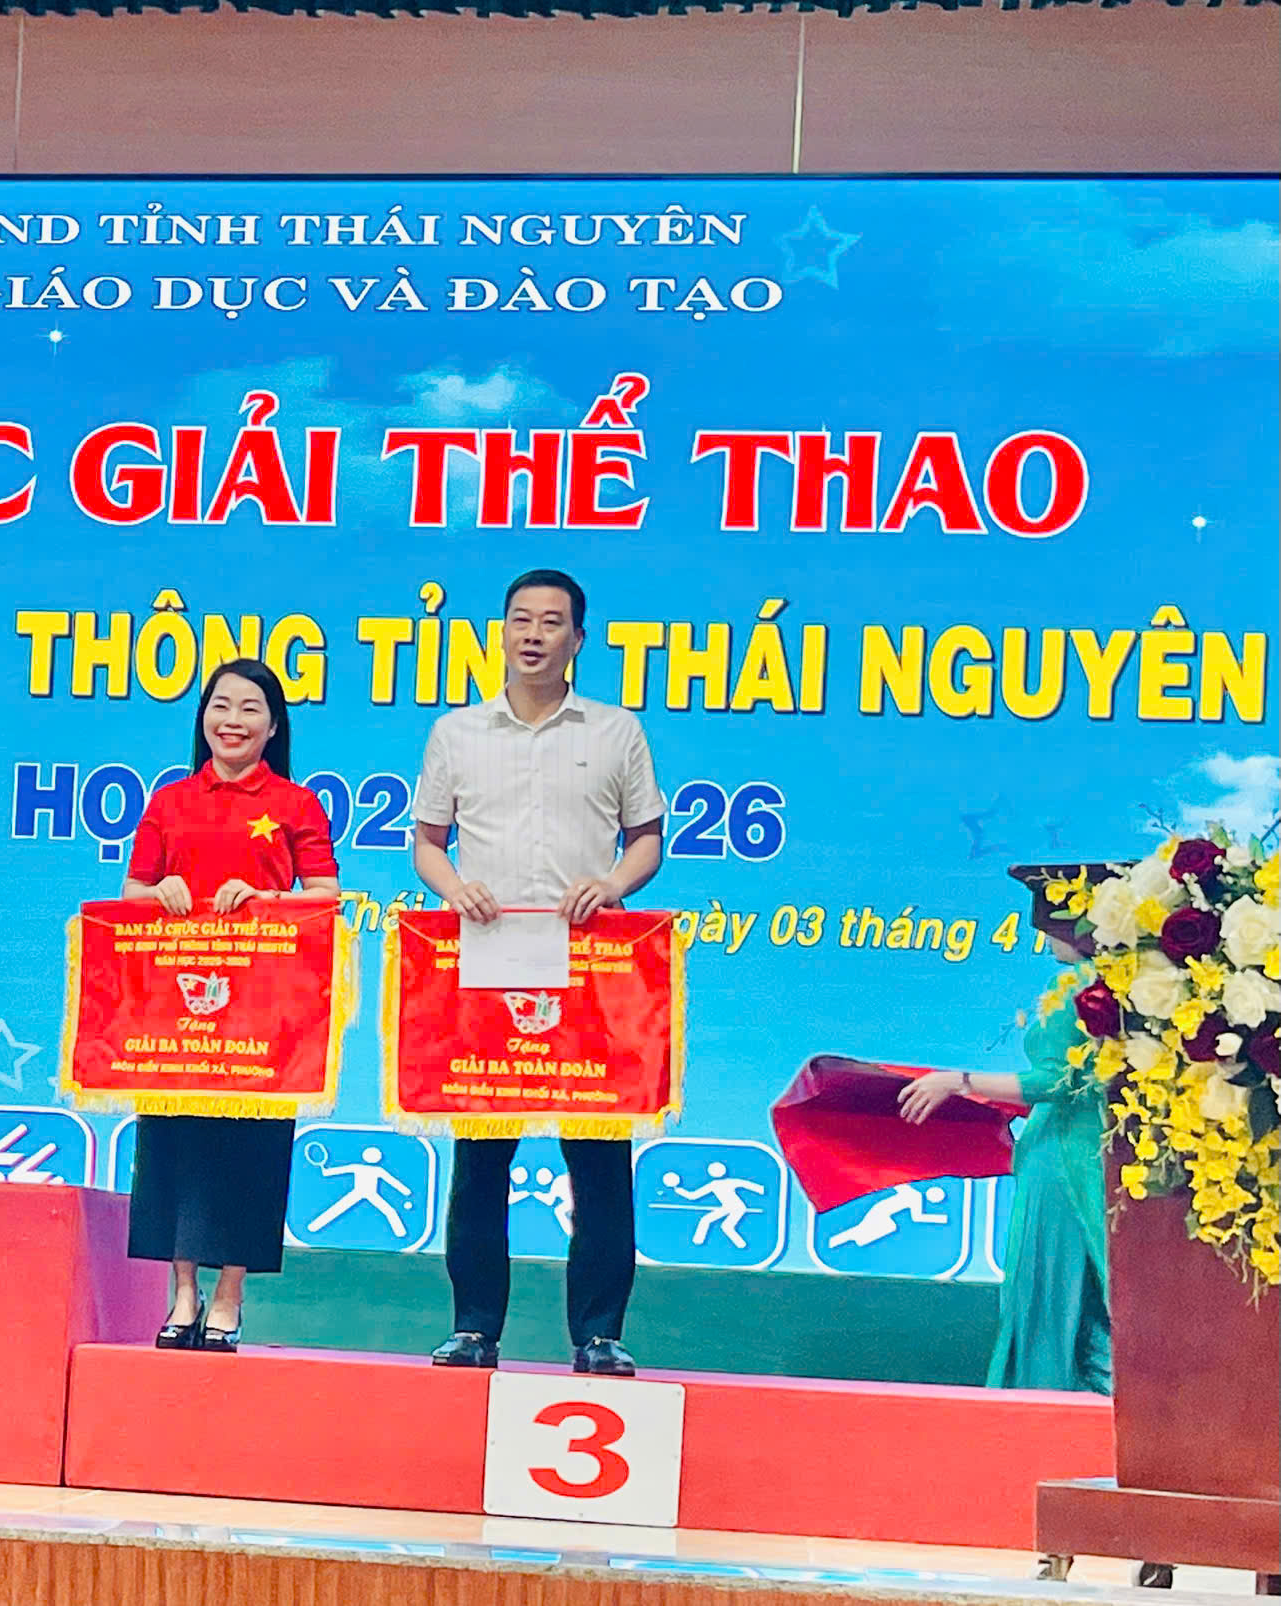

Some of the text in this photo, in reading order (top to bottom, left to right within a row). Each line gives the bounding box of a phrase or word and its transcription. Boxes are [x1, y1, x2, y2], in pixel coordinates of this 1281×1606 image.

[99, 202, 261, 245] TỈNH
[280, 205, 440, 245] THÁI
[460, 205, 747, 245] NGUYÊN
[153, 276, 308, 319] DỤC
[328, 266, 429, 311] VÀ
[447, 266, 607, 311] ĐÀO
[629, 276, 783, 321] TẠO
[69, 390, 342, 526] GIẢI
[381, 372, 651, 530] THỂ
[690, 429, 1089, 538] THAO
[15, 588, 328, 706] THÔNG
[357, 580, 569, 707] TỈN
[607, 597, 829, 714] THÁI
[858, 606, 1269, 725] NGUYÊN
[672, 899, 759, 955] gày
[769, 905, 826, 946] 03
[839, 906, 978, 963] tháng
[991, 911, 1021, 953] 4
[158, 1038, 179, 1053] BA
[487, 1060, 510, 1075] BA
[512, 1057, 558, 1076] TOÀN
[528, 1401, 630, 1499] 3
